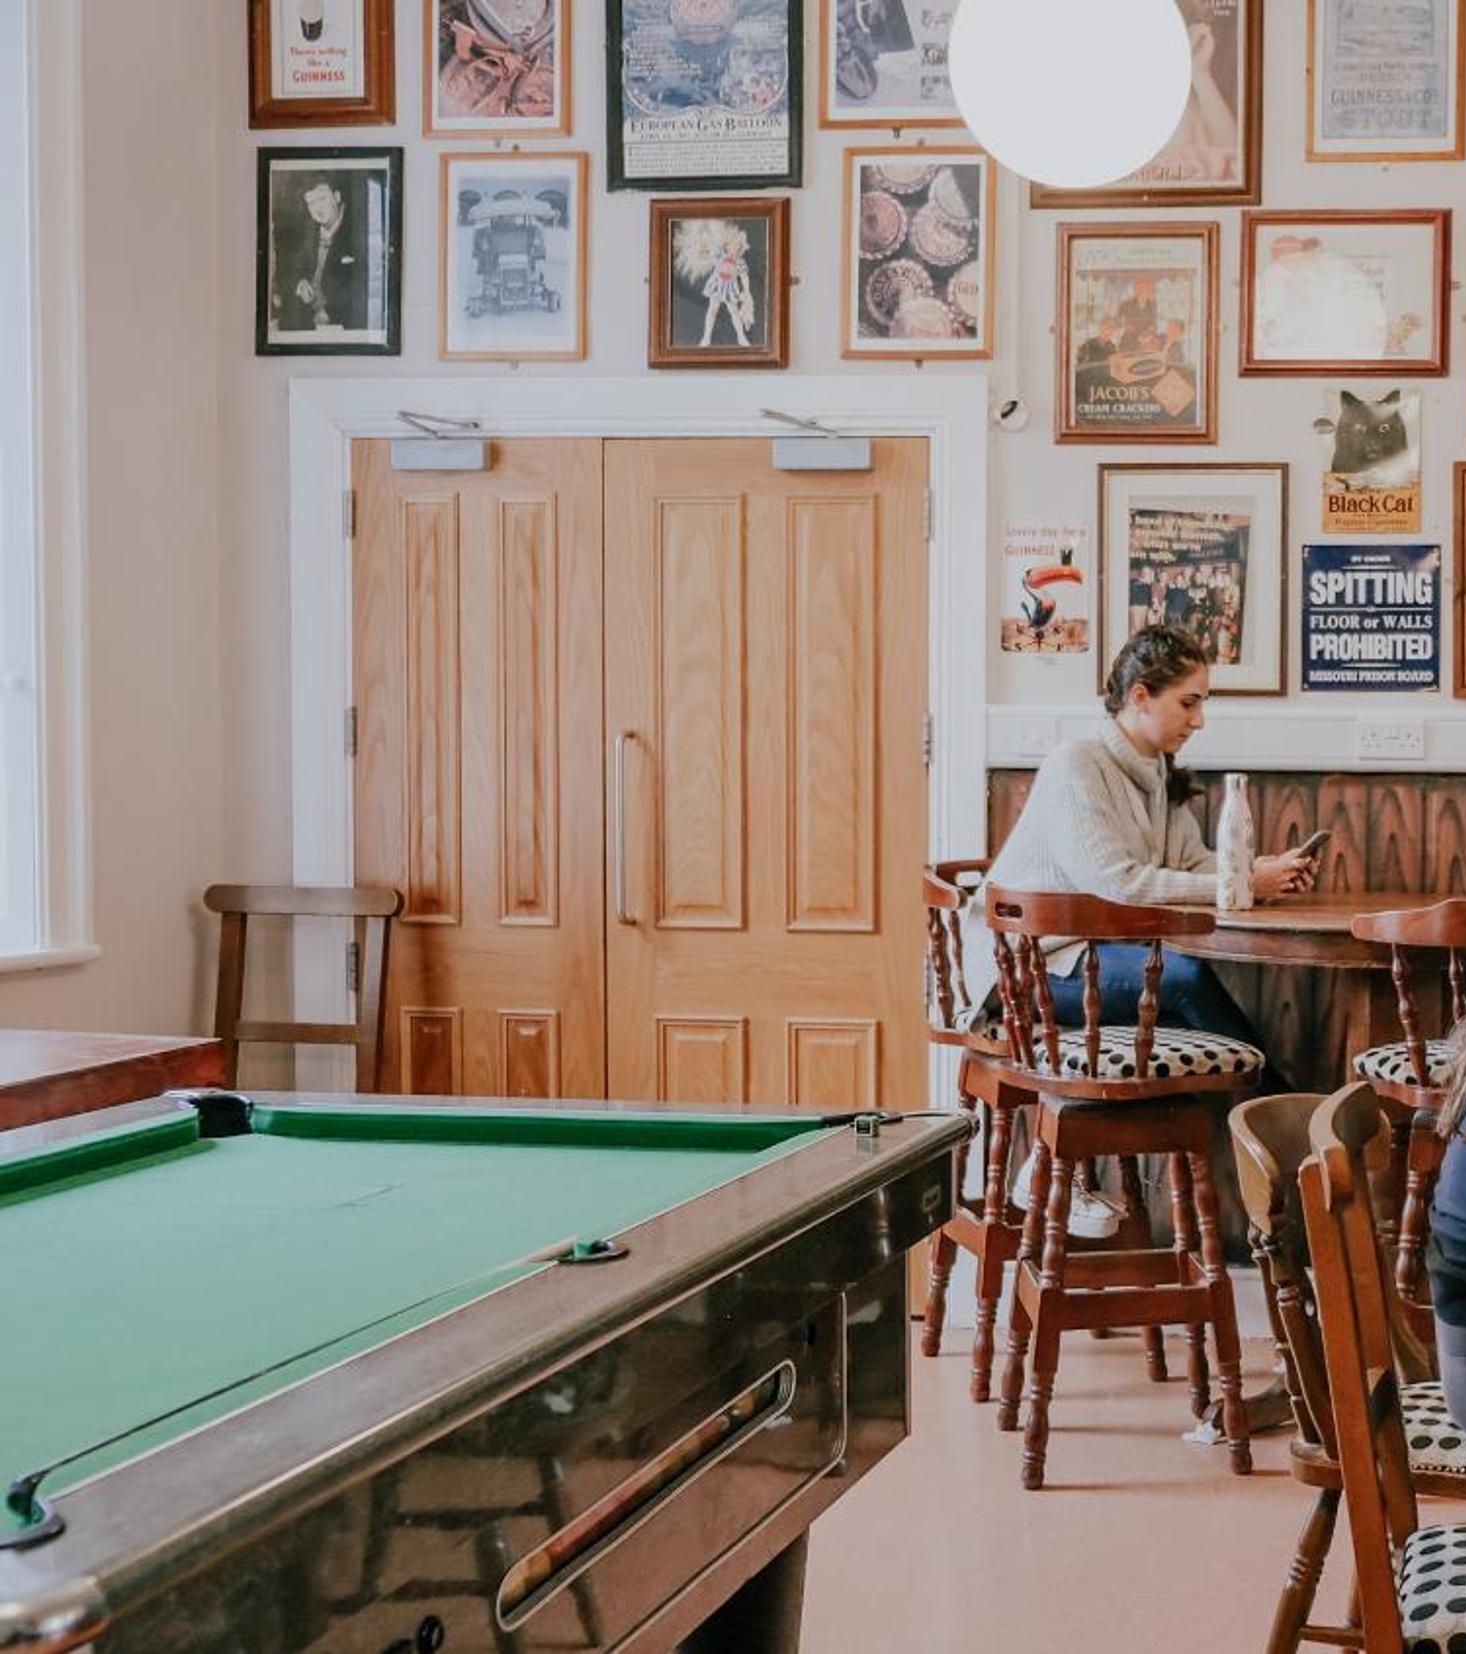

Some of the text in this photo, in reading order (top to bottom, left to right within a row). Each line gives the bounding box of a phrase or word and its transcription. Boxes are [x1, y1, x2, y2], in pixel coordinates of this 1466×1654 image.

[292, 70, 345, 82] GUINNESS
[1089, 384, 1152, 403] JACOB'S
[1328, 494, 1413, 513] Black Cat
[1309, 570, 1433, 605] SPITTING
[1310, 615, 1433, 629] FLOOR or WALLS
[1309, 633, 1434, 661] PROHIBITED
